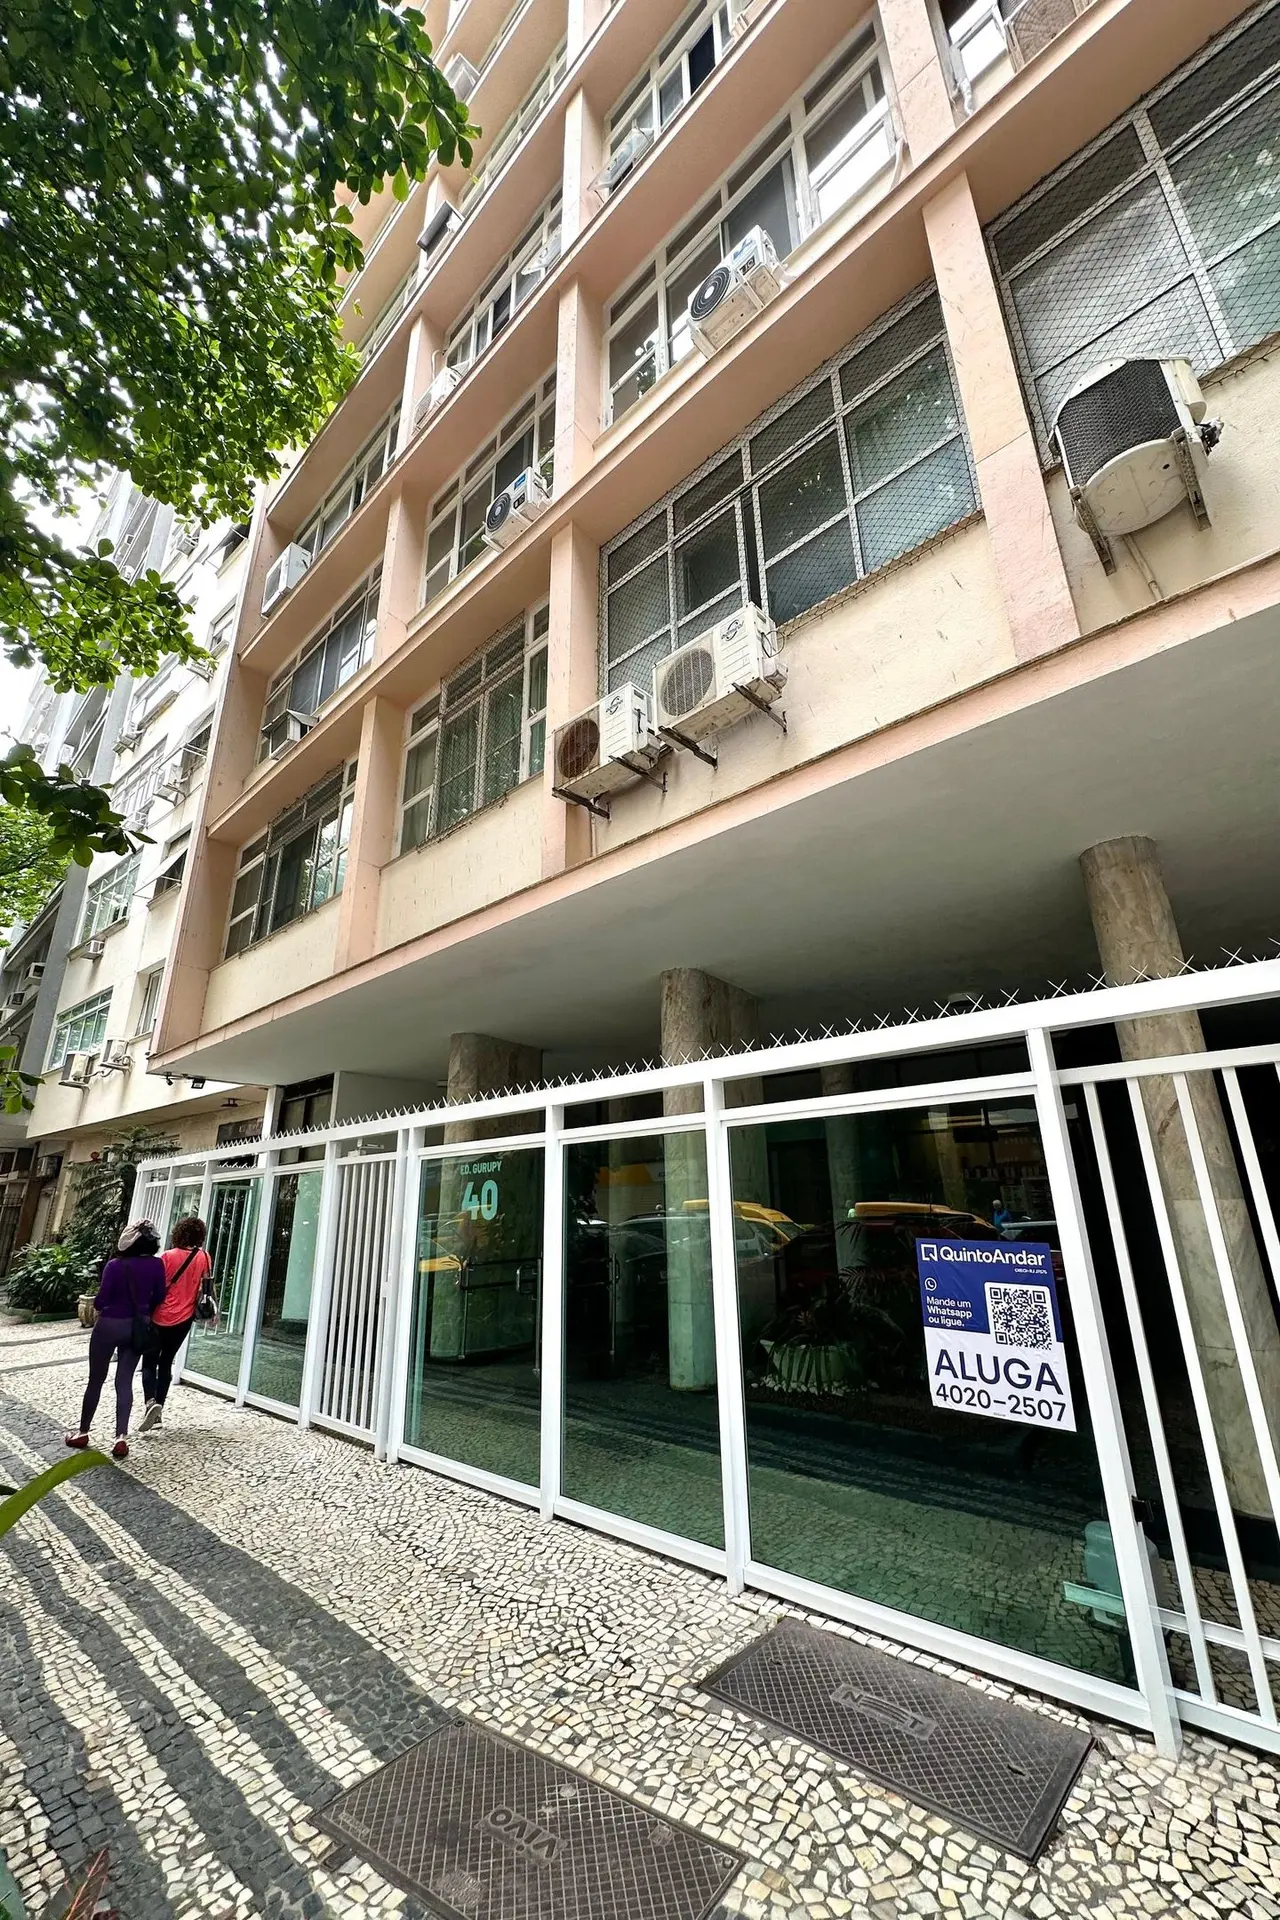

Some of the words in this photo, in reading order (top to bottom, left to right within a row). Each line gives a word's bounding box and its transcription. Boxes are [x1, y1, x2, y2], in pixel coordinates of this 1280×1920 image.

[460, 1164, 471, 1175] ED.
[472, 1161, 502, 1174] GURUPY
[461, 1180, 498, 1220] 40
[939, 1246, 1045, 1266] QuintoAndar
[926, 1295, 956, 1307] Mande
[956, 1300, 972, 1308] um
[927, 1304, 973, 1320] Whatsapp
[928, 1316, 940, 1324] ou
[940, 1315, 965, 1327] ligue.
[934, 1348, 1064, 1396] ALUGA
[936, 1383, 1066, 1422] 4020-2507
[841, 1690, 924, 1729] NET
